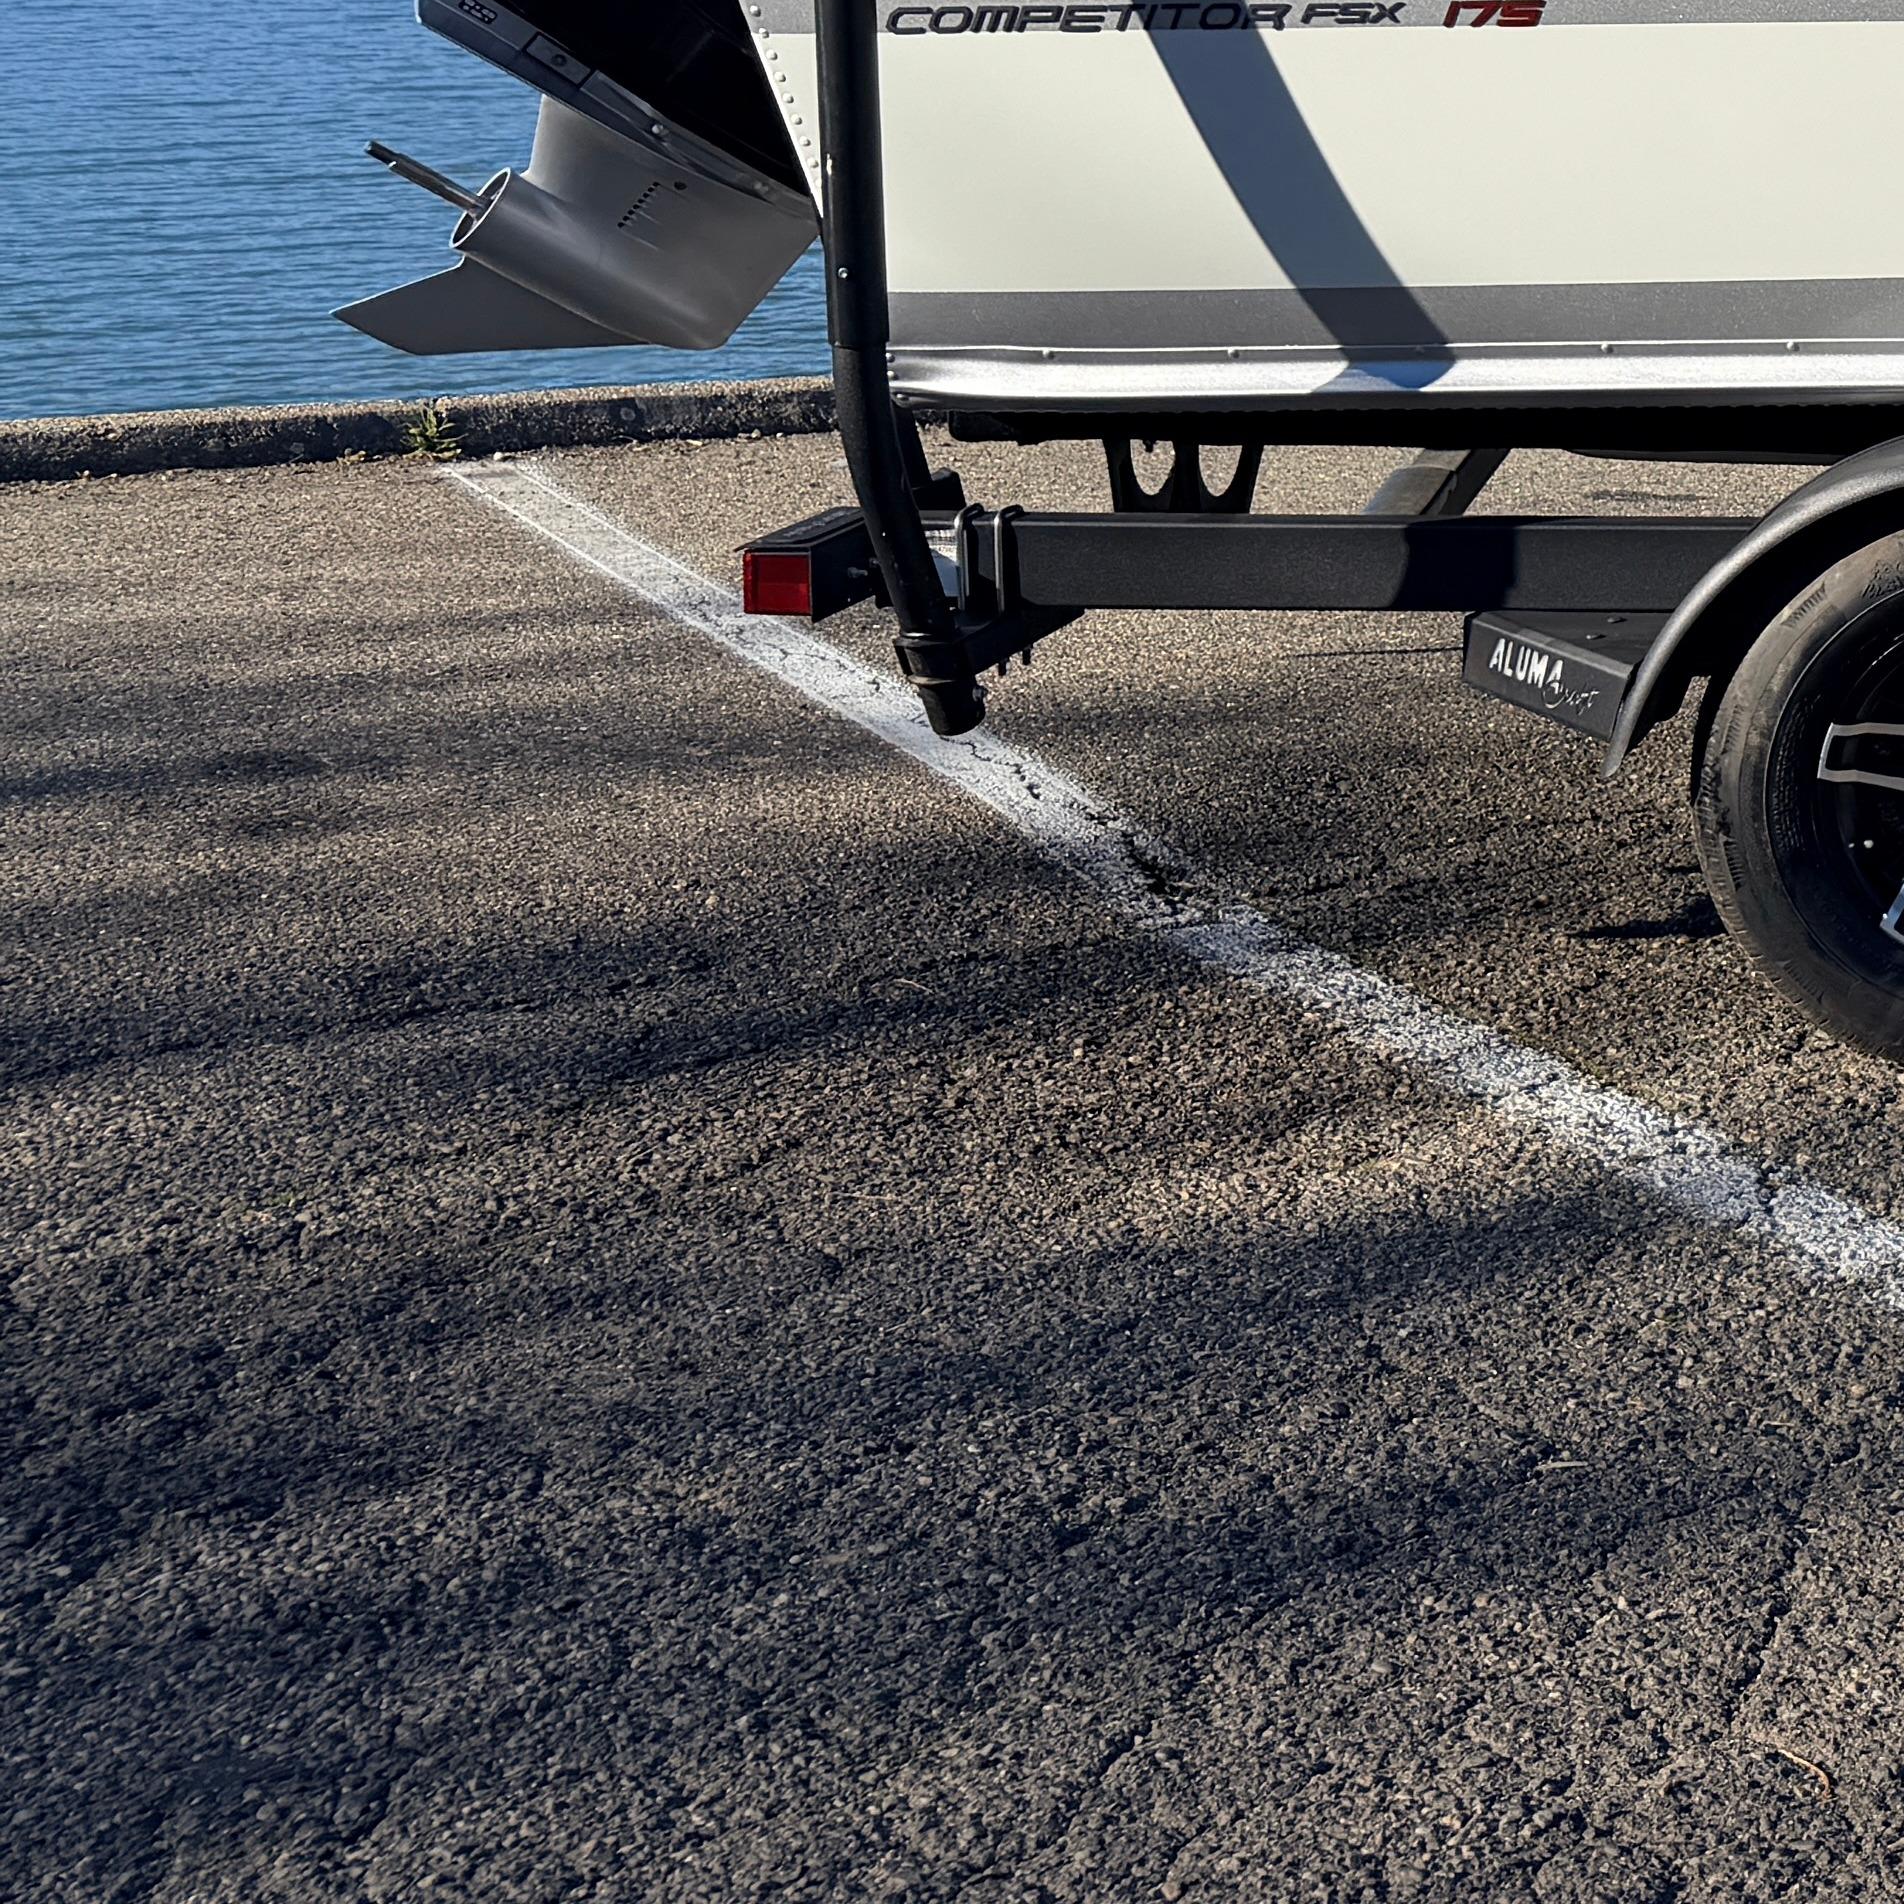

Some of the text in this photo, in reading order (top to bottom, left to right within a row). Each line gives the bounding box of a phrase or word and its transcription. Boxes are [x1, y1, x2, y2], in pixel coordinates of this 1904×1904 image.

[885, 0, 1546, 34] COMPETITOR FSX 175
